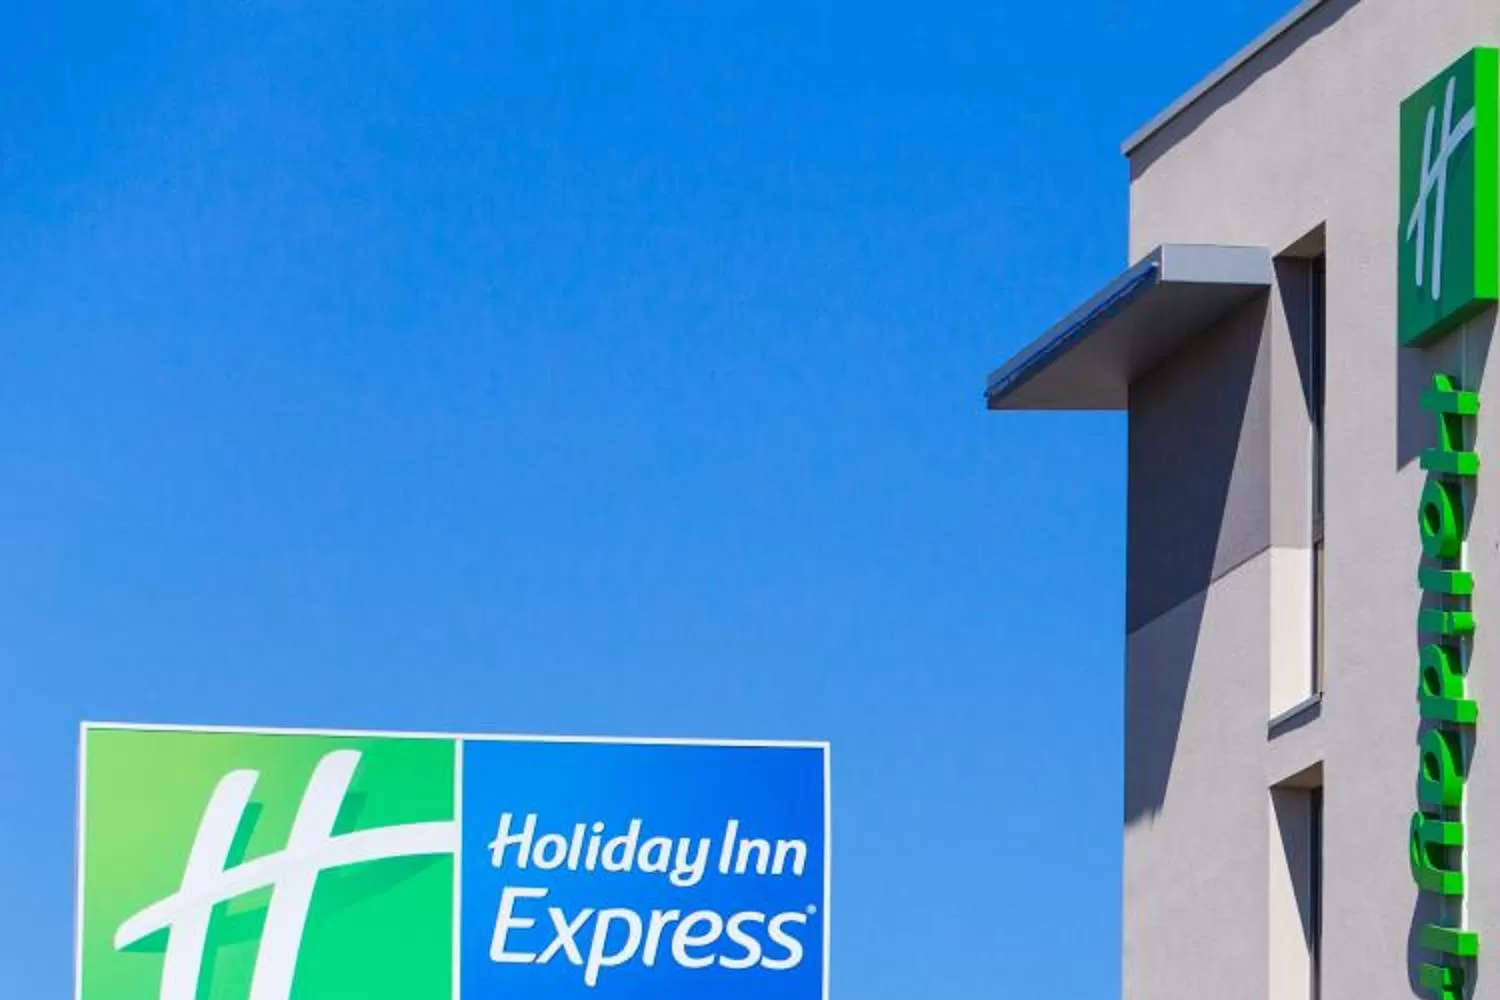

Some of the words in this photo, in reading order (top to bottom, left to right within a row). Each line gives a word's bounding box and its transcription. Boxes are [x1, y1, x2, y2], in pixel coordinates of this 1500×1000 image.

[488, 812, 711, 887] Holiday
[718, 818, 808, 877] Inn
[488, 886, 808, 988] Express
